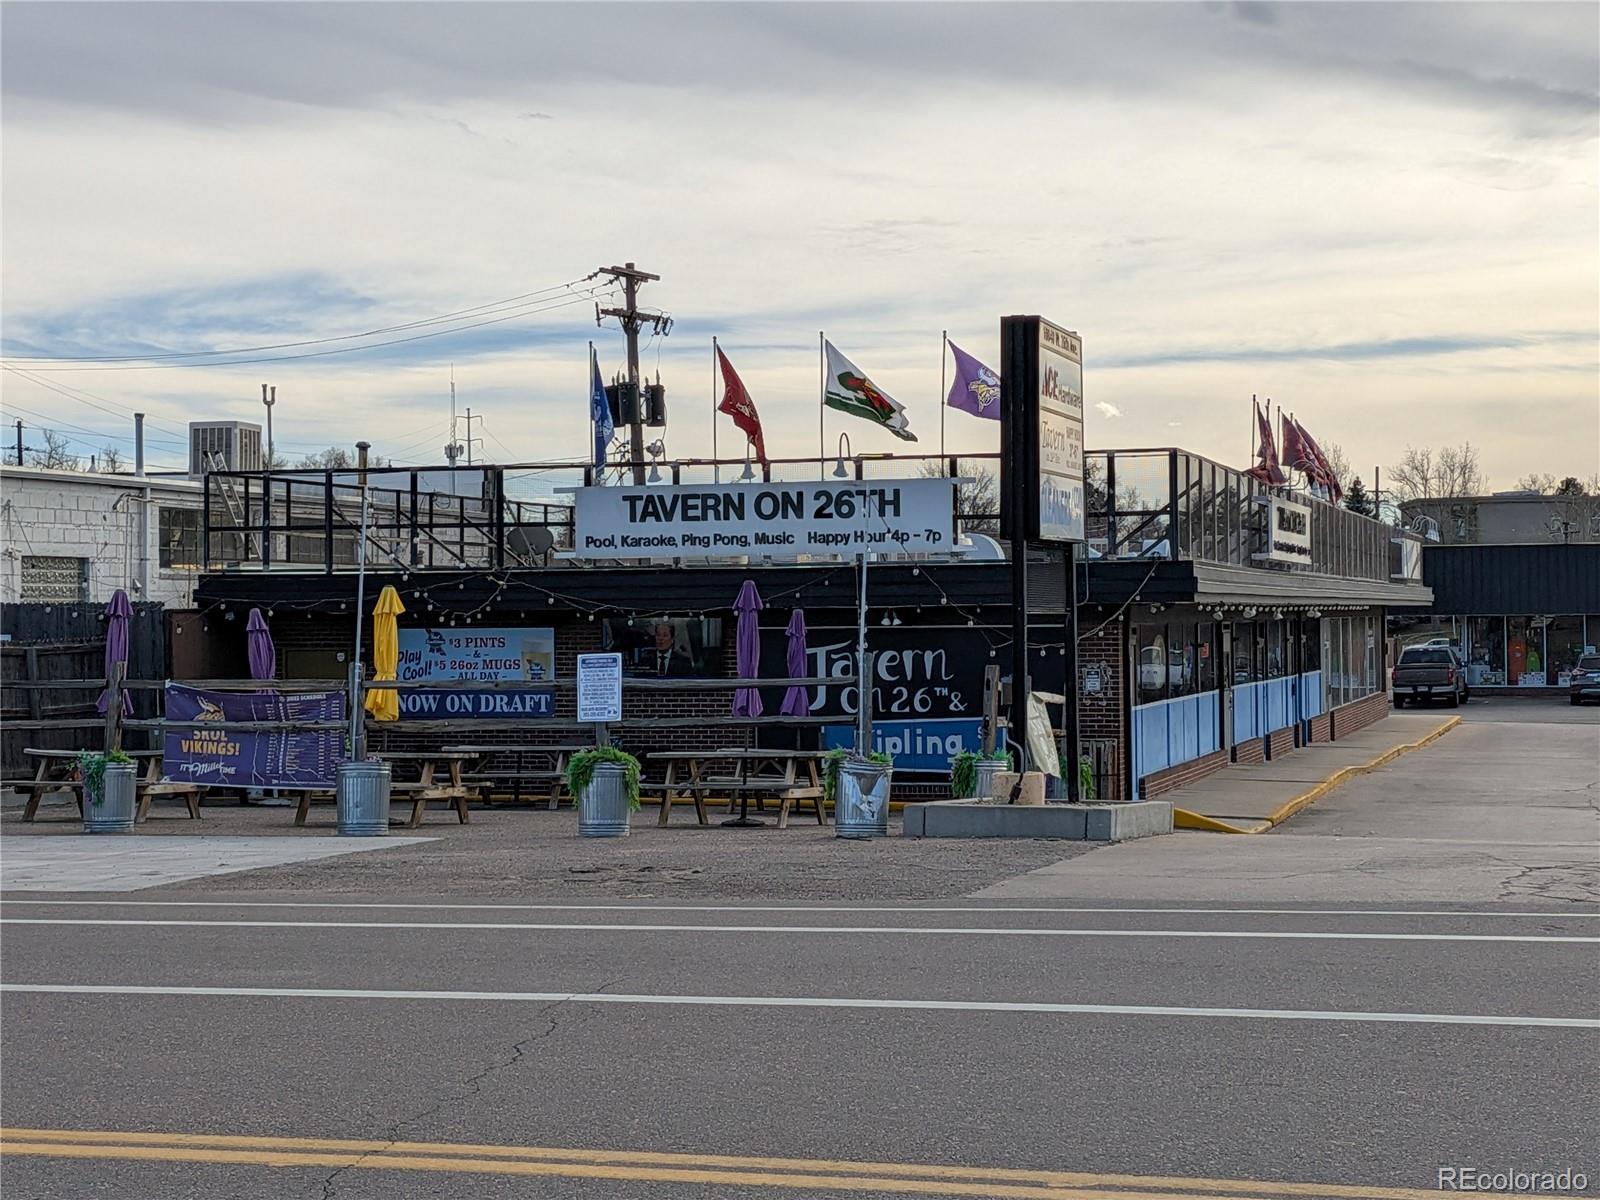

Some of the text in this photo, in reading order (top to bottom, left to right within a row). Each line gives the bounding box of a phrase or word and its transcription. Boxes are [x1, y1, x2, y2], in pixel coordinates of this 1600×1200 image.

[1042, 360, 1059, 401] ACE
[622, 489, 901, 523] TAVERN ON 26TH
[585, 530, 795, 549] Pool, Karaoke, Ping Pong, Music
[807, 531, 851, 546] Happy
[853, 529, 887, 544] Hour
[890, 529, 910, 544] 4p
[924, 528, 942, 544] 7p
[464, 637, 506, 648] PINTS
[472, 650, 481, 659] &
[402, 660, 433, 680] Cool!
[450, 659, 479, 671] 26oz
[482, 659, 521, 670] MUGS
[457, 672, 500, 682] ALL DAY
[806, 640, 955, 711] Tavern
[397, 694, 551, 713] NOW ON DRAFT
[948, 691, 968, 712] &
[181, 740, 240, 756] VIKINGS!
